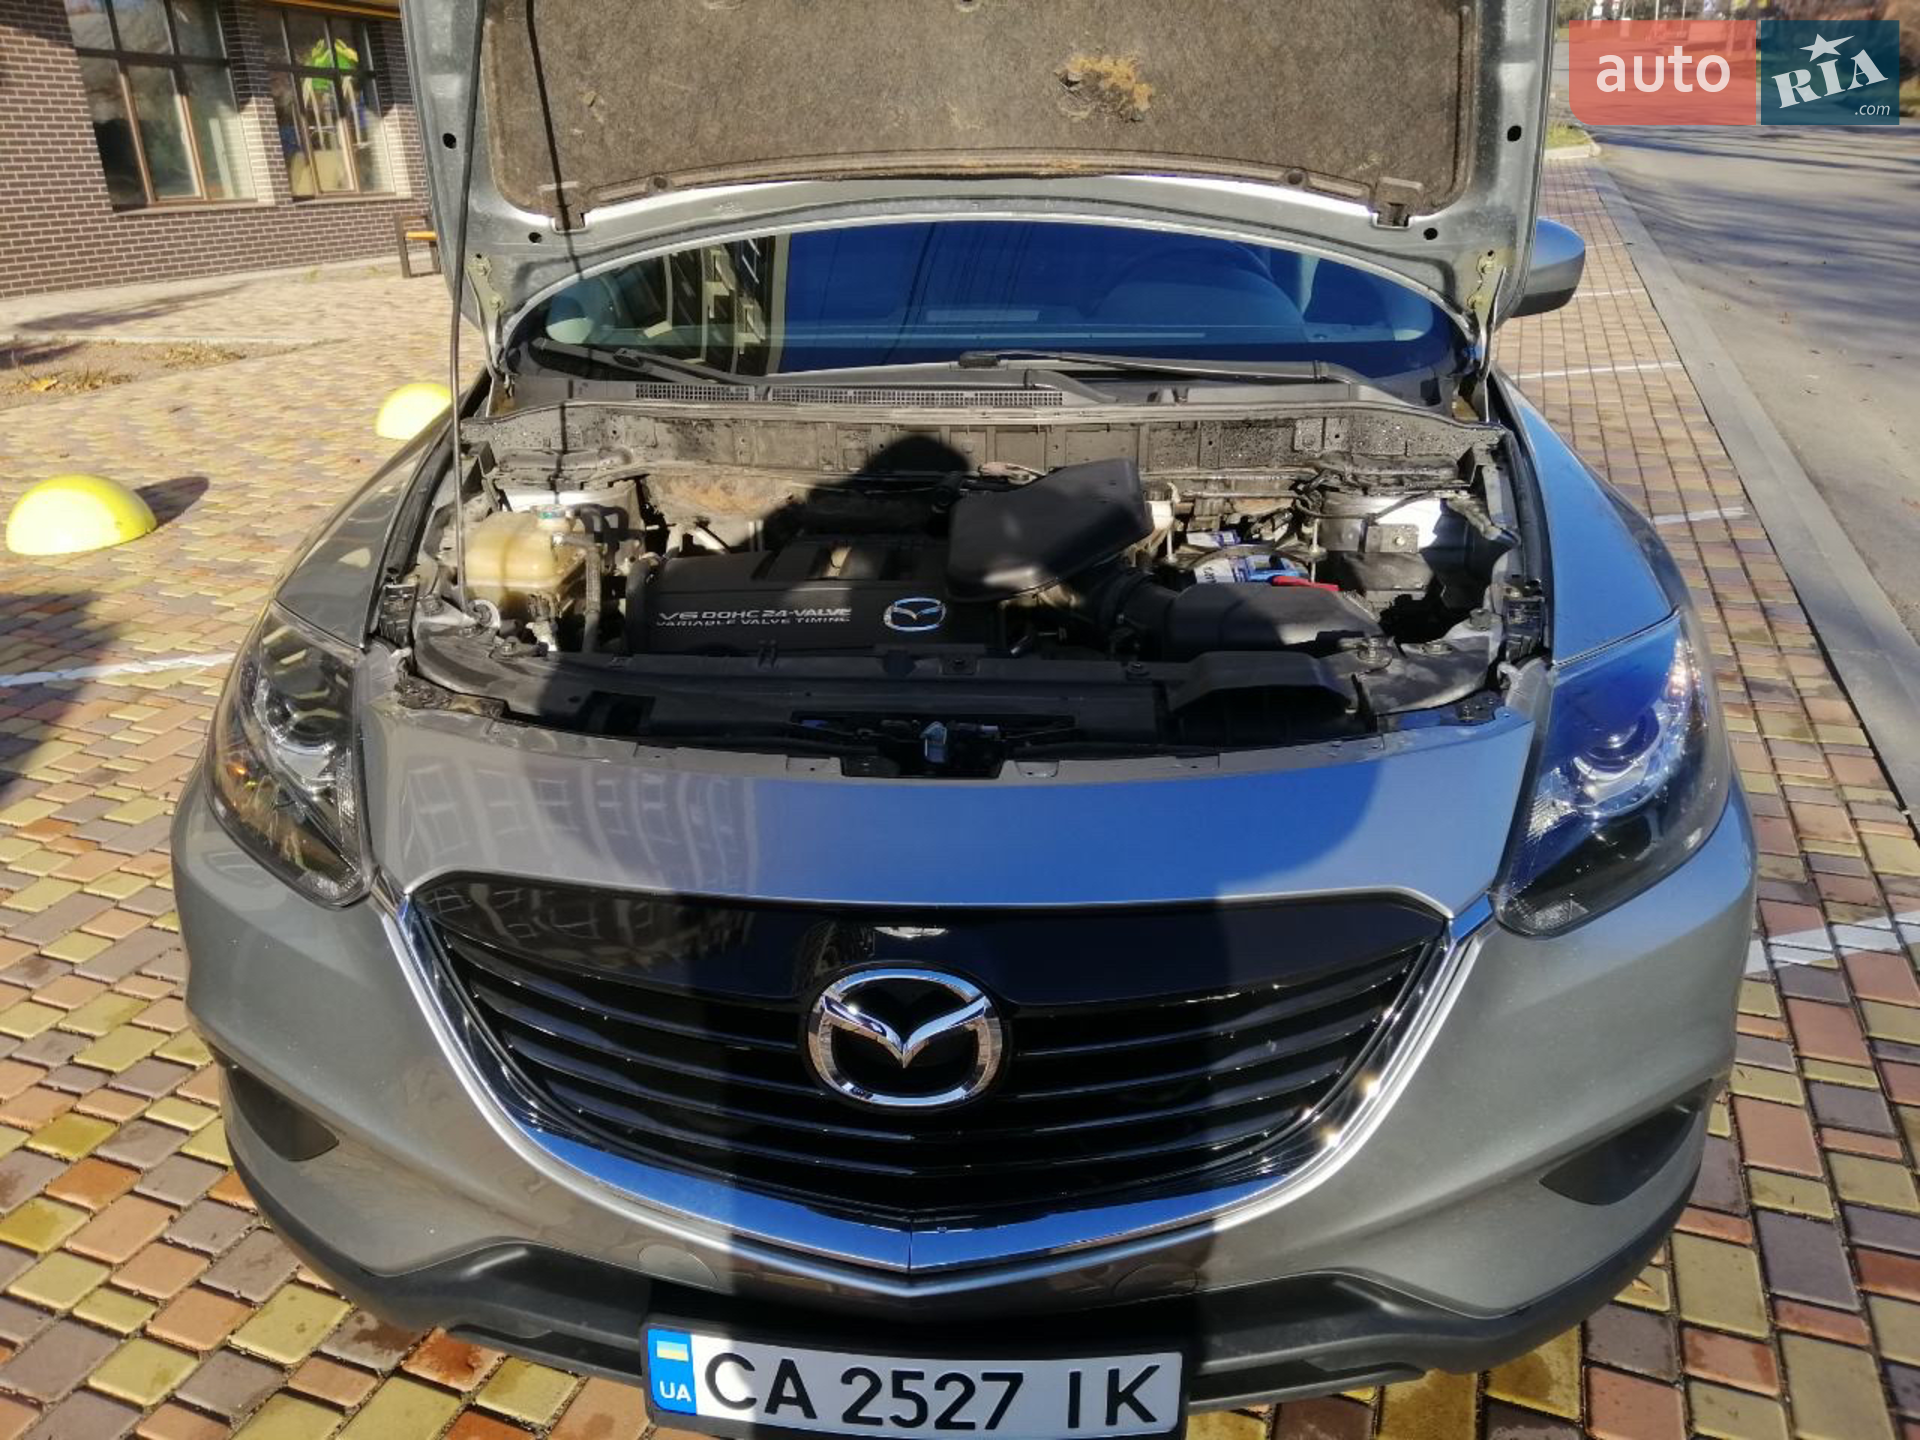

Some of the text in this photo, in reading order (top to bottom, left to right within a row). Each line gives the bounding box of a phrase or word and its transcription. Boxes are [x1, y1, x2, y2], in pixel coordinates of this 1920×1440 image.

[658, 607, 852, 621] V6 DOHC 24-VALVE
[740, 618, 791, 626] VALVE
[659, 1380, 692, 1403] UA
[704, 1352, 1161, 1431] CA 2527 IK
